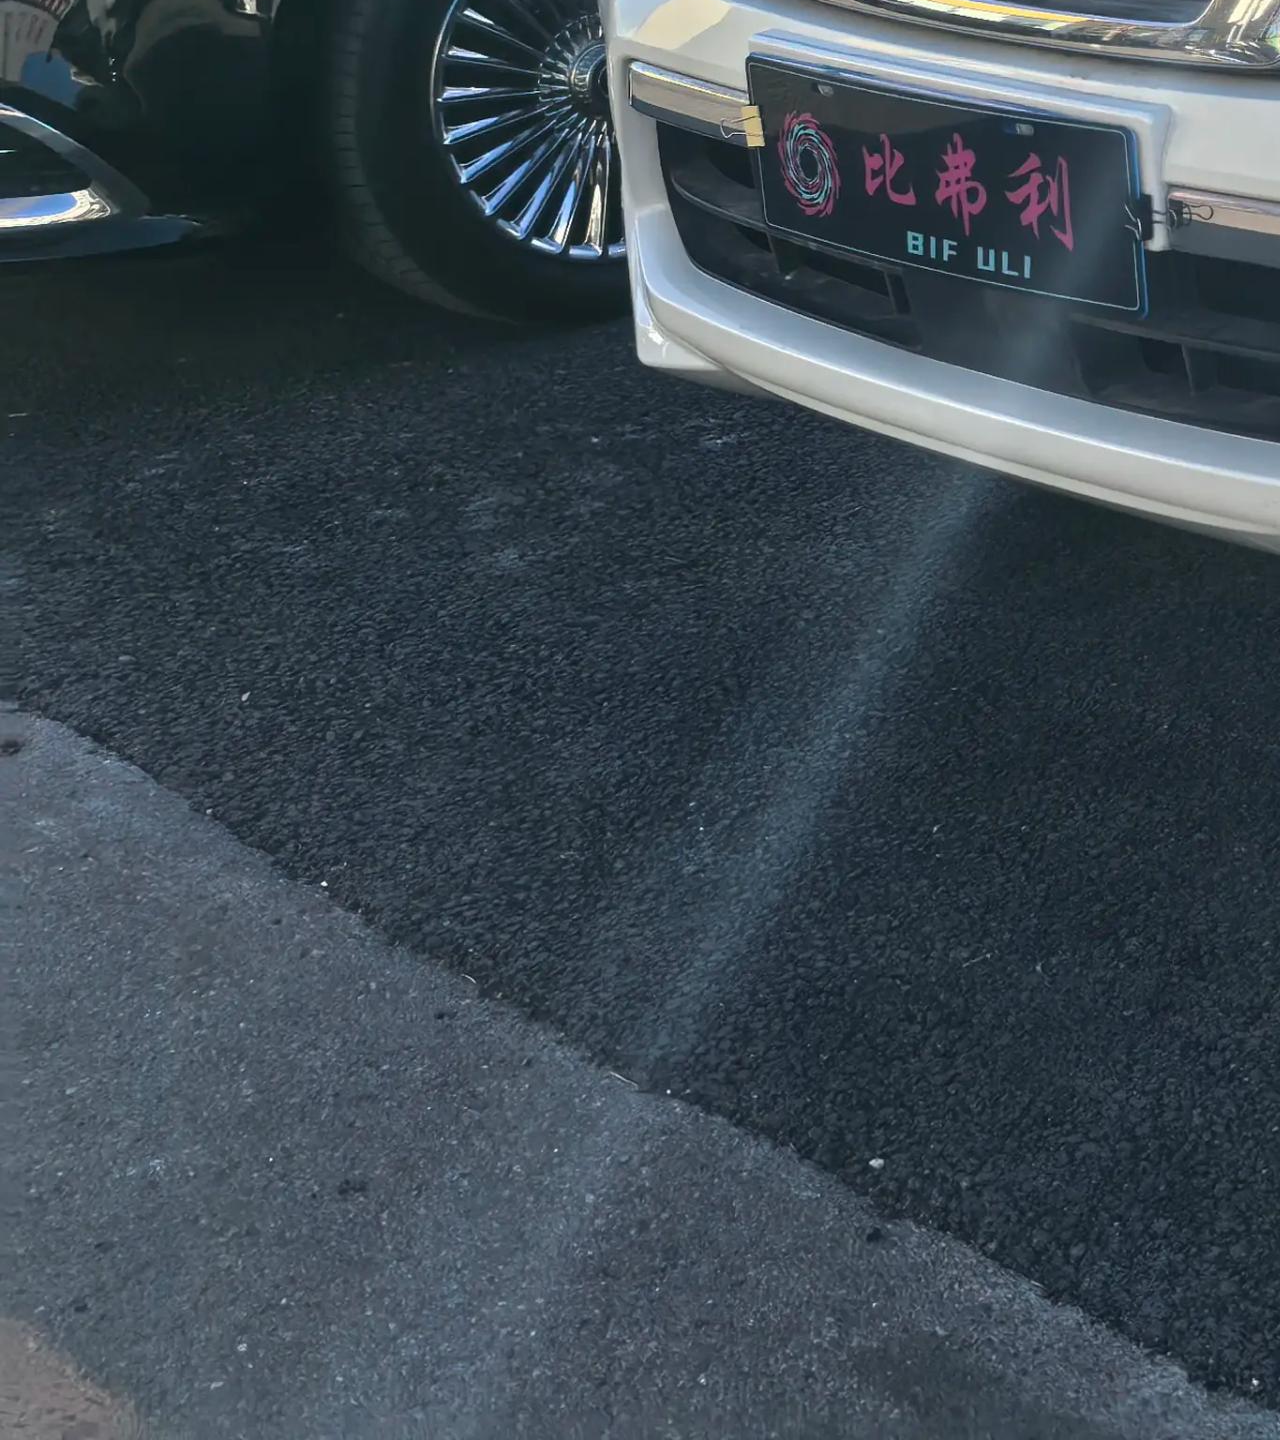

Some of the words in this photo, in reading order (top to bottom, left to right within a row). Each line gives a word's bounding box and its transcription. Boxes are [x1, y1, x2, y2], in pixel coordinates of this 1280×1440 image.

[862, 131, 1075, 252] 比弗利
[906, 230, 959, 262] BIF
[976, 245, 1032, 280] ULI
